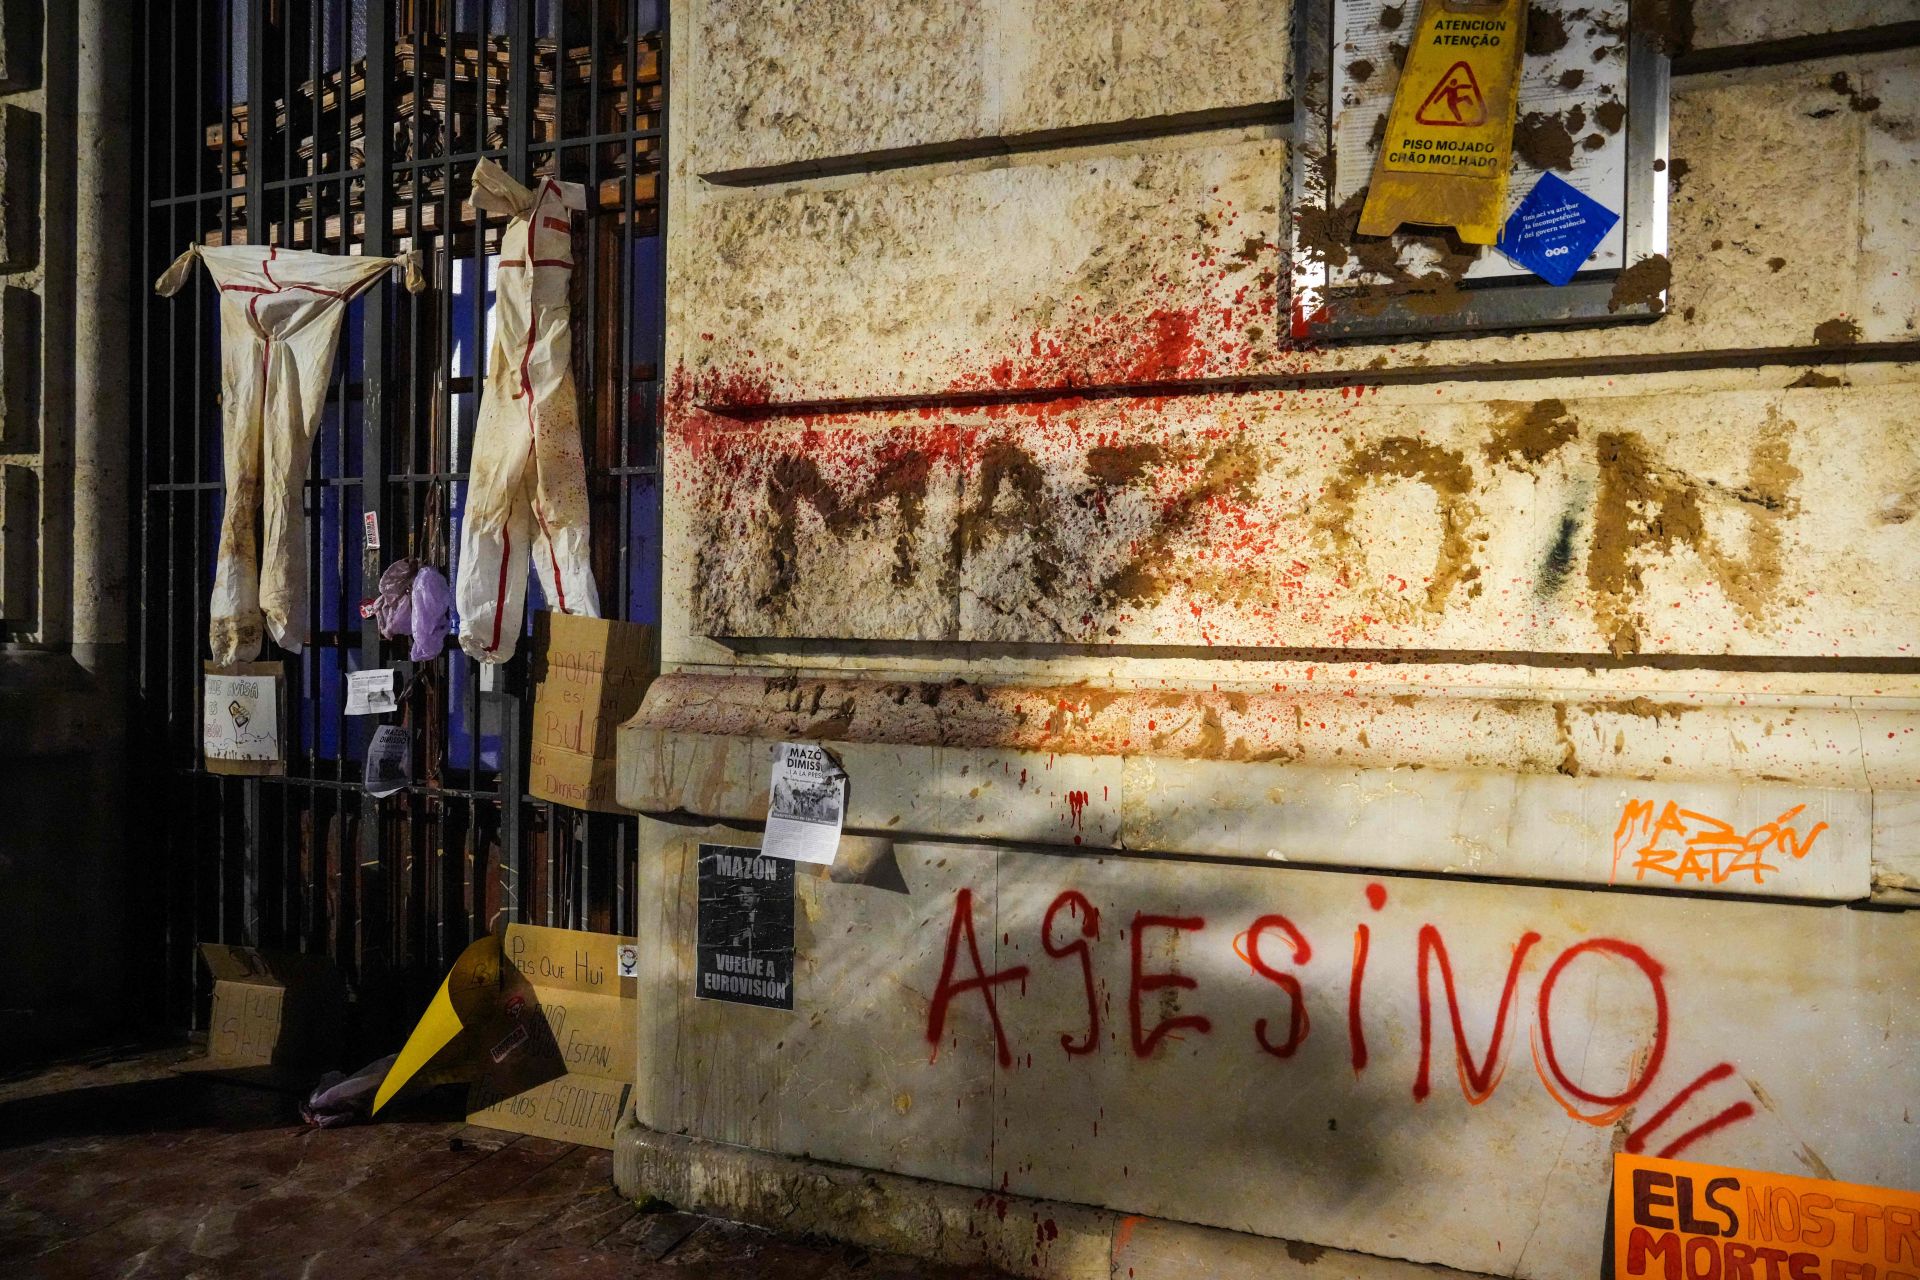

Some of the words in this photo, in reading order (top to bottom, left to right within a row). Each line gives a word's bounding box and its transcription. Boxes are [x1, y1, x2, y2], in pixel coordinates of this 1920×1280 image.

[1433, 34, 1500, 48] ATENÇÃO
[1402, 139, 1433, 150] PISO
[1435, 141, 1495, 153] MOJADO
[1389, 152, 1426, 164] CHÃO
[1429, 154, 1498, 167] MOLHADO
[1535, 226, 1558, 237] govern
[715, 953, 764, 976] VUELVE
[766, 960, 776, 978] A
[704, 972, 786, 1000] EUROVISIÓN
[1632, 1168, 1741, 1238] ELS
